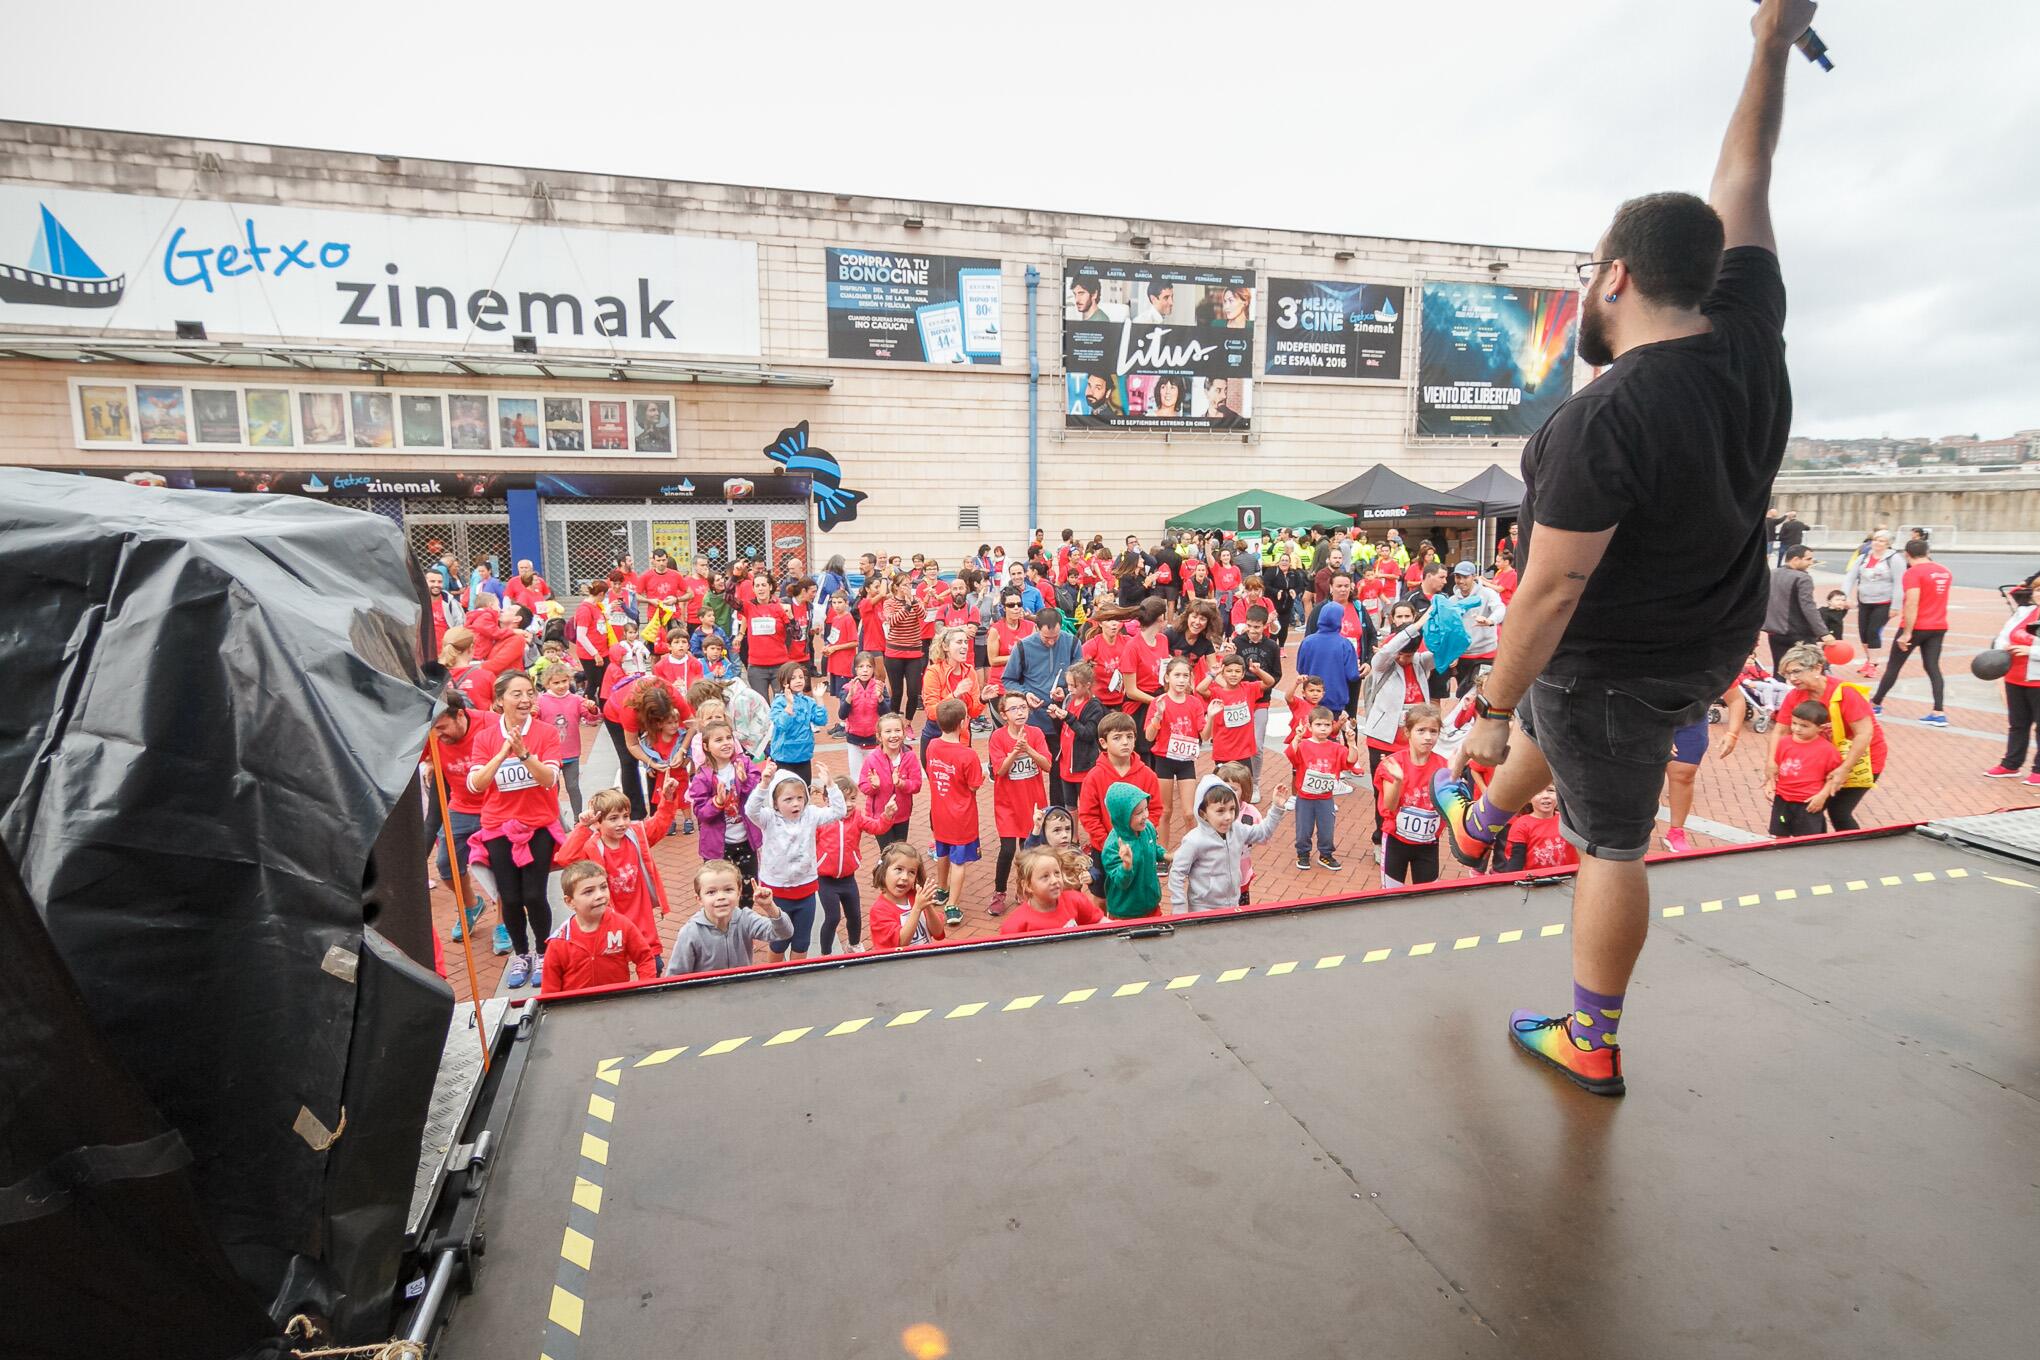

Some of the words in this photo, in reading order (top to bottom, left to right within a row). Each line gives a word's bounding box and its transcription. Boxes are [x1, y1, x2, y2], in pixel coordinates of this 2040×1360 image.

[164, 218, 350, 293] Getxo
[840, 254, 892, 267] COMPRA
[894, 257, 911, 269] YA
[913, 260, 929, 270] TU
[839, 267, 928, 285] BONOCINE
[336, 263, 676, 340] zinemak
[1302, 297, 1344, 313] MEJOR
[1301, 312, 1344, 332] CINE
[1349, 310, 1375, 323] Getxo
[1353, 321, 1394, 334] zinemak
[1276, 341, 1346, 355] INDEPENDIENTE
[1274, 355, 1287, 366] DE
[1288, 354, 1324, 367] ESPAÑA
[1325, 357, 1347, 368] 2016
[1423, 386, 1459, 404] VIENTO
[1460, 387, 1473, 404] DE
[1474, 387, 1521, 405] LIBERTAD
[333, 474, 371, 489] Getxo
[366, 479, 442, 494] zinemak
[1364, 509, 1374, 518] EL
[1375, 508, 1407, 518] CORREO
[1171, 741, 1197, 756] 3015
[1307, 777, 1335, 792] 2033
[1403, 816, 1437, 834] 1015
[607, 929, 623, 948] M
